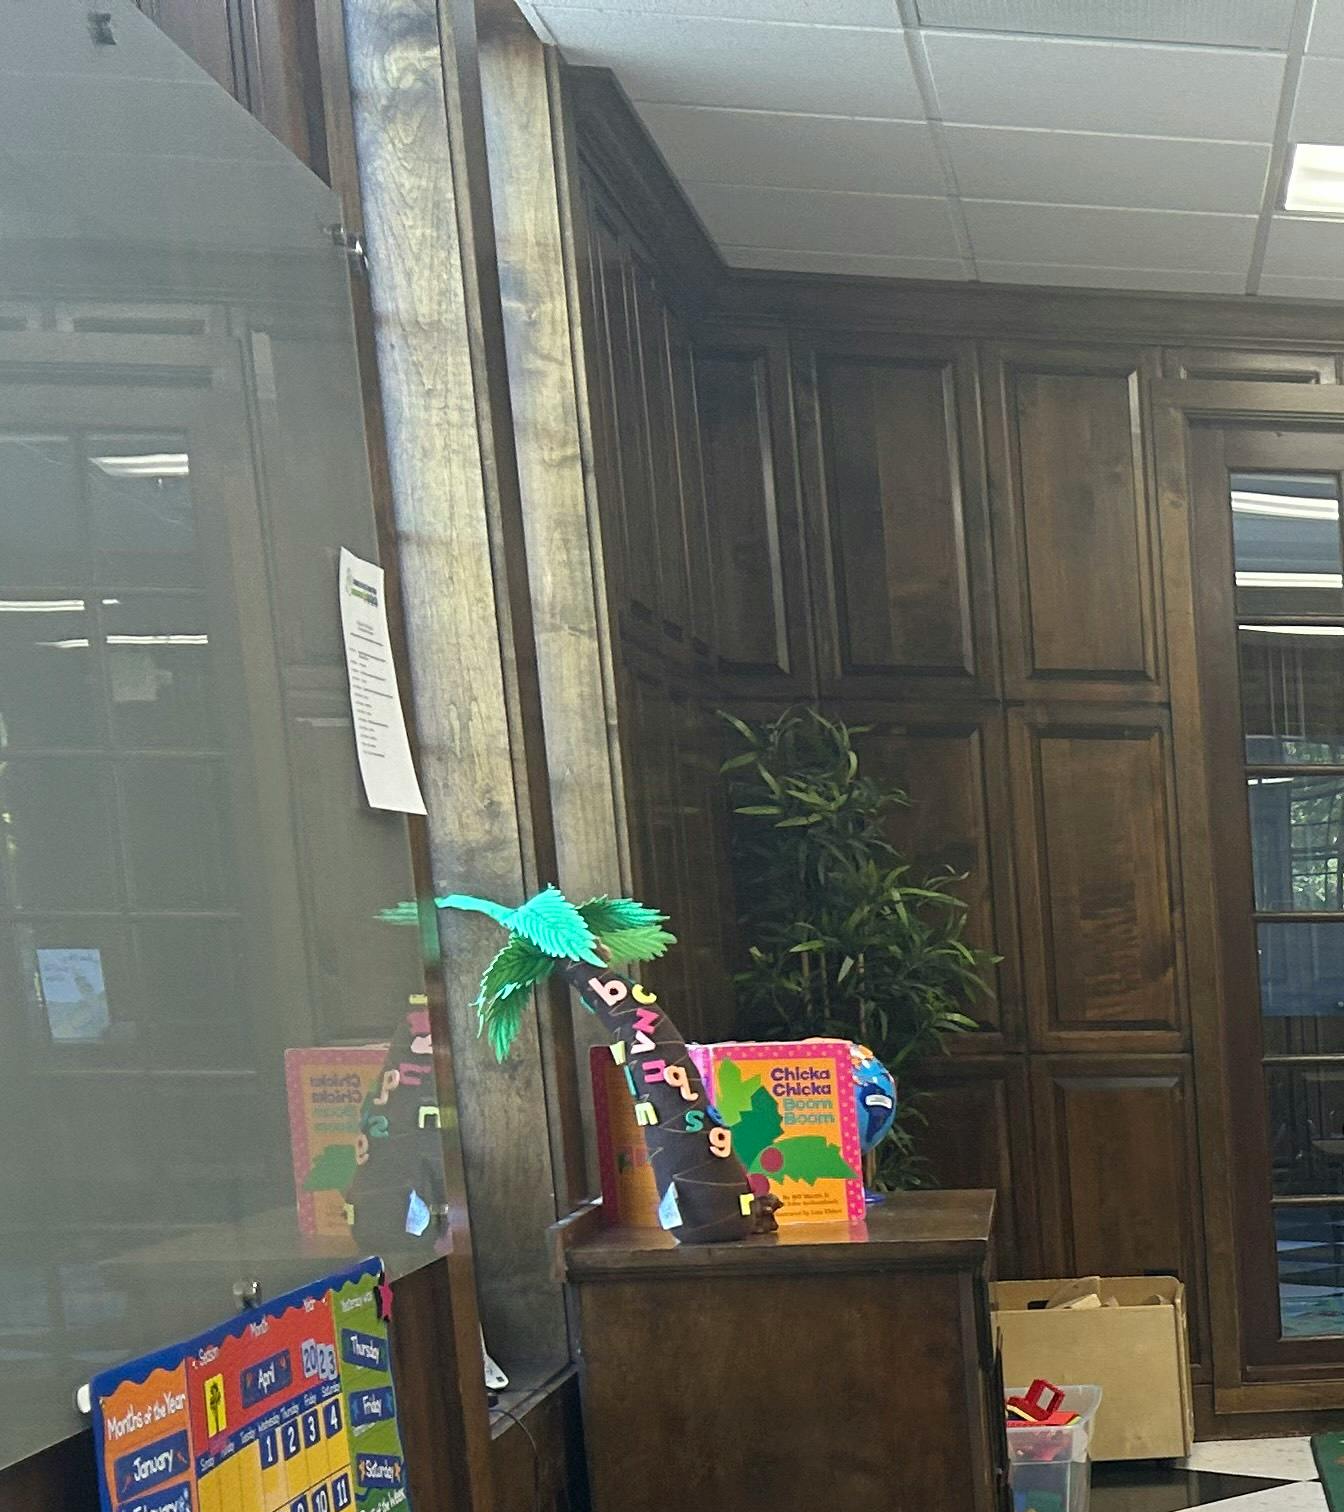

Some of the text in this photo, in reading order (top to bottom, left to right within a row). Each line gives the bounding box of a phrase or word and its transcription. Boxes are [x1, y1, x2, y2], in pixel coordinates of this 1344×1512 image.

[588, 977, 628, 1007] b
[631, 983, 657, 1005] c
[770, 1066, 830, 1081] Chicka
[772, 1082, 832, 1097] Chicka
[783, 1098, 833, 1110] Boom
[685, 1110, 704, 1133] s
[784, 1113, 835, 1125] Boom
[709, 1127, 732, 1158] g
[350, 1335, 380, 1365] Thursday
[257, 1362, 275, 1394] April
[108, 1390, 186, 1440] Months of the Year
[362, 1395, 382, 1418] Friday
[266, 1435, 274, 1462] 1
[287, 1425, 297, 1451] 2
[308, 1416, 316, 1442] 3
[330, 1404, 338, 1430] 4
[133, 1449, 174, 1482] January
[365, 1458, 394, 1480] Saturday
[336, 1479, 348, 1507] 11
[381, 1497, 391, 1512] the
